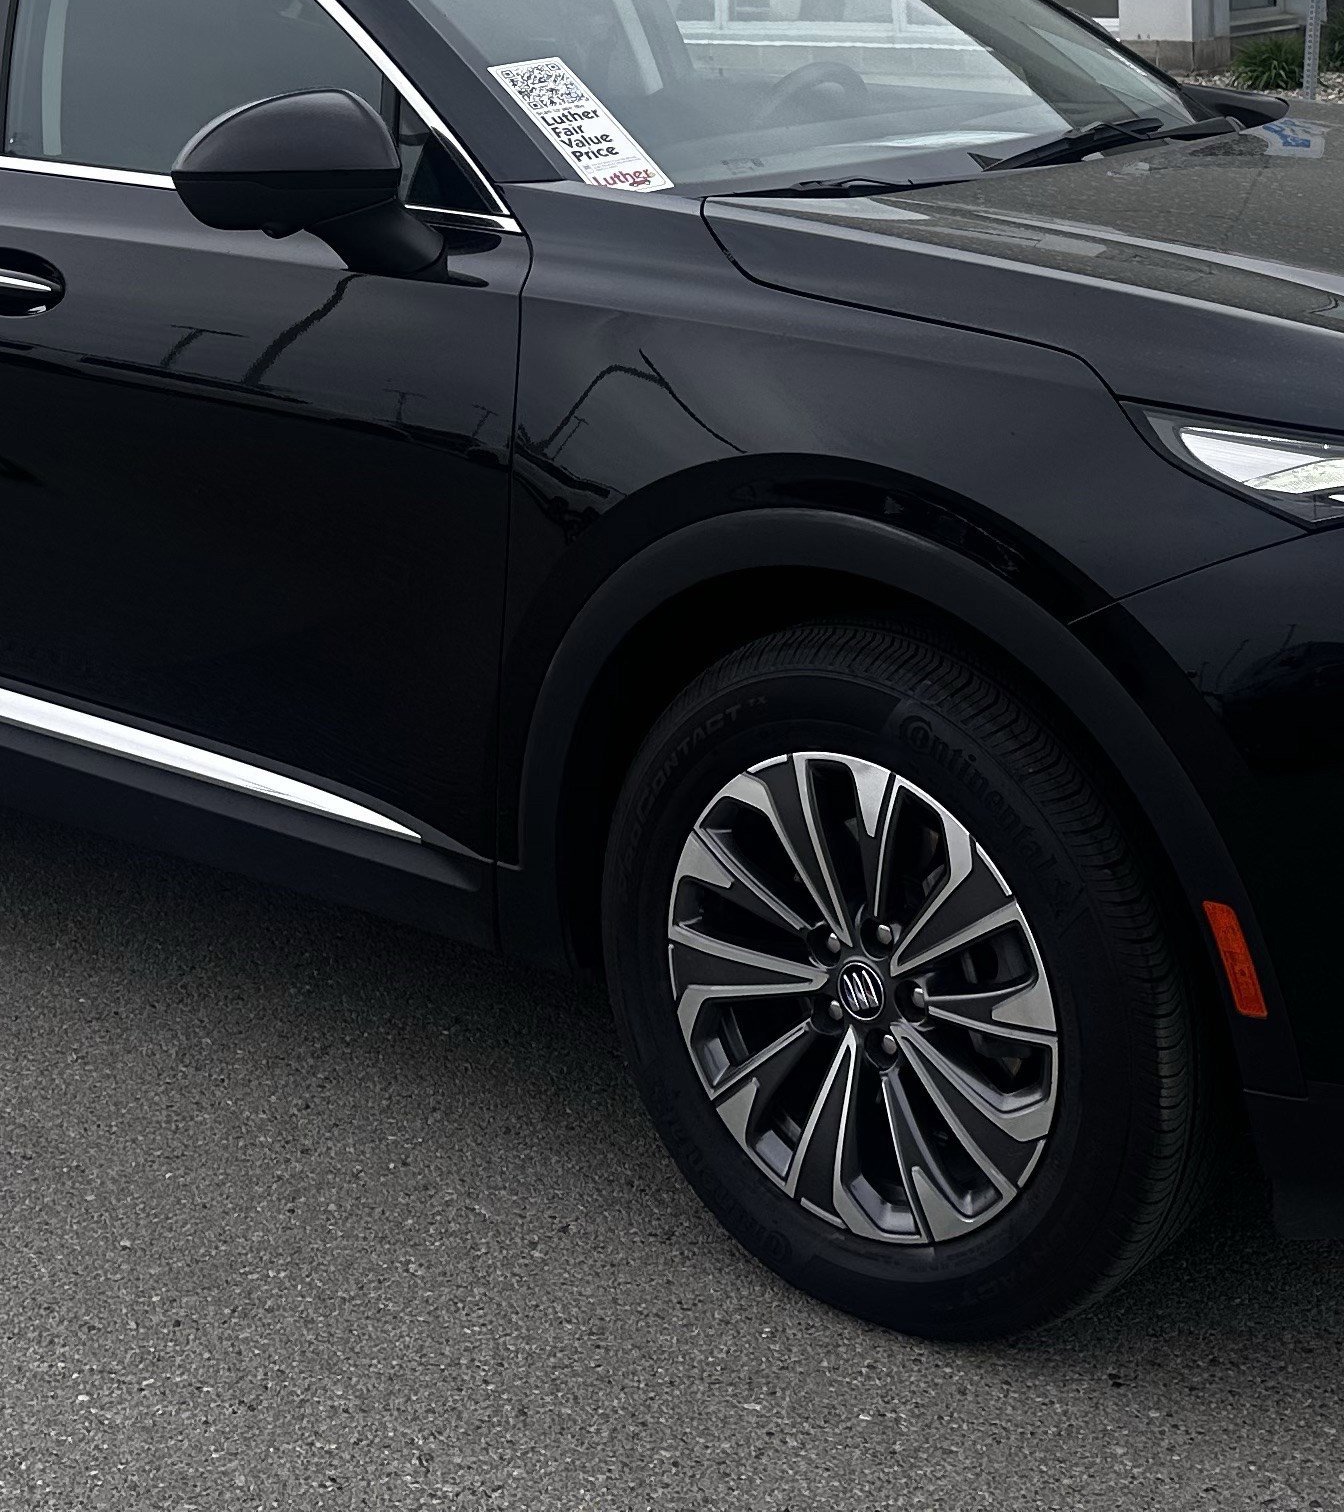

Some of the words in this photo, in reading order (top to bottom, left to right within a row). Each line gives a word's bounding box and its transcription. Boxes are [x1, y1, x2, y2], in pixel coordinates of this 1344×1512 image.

[541, 108, 600, 126] Luther
[551, 124, 585, 138] Fair
[560, 133, 613, 149] Value
[571, 146, 619, 162] Price
[592, 168, 652, 187] Luther
